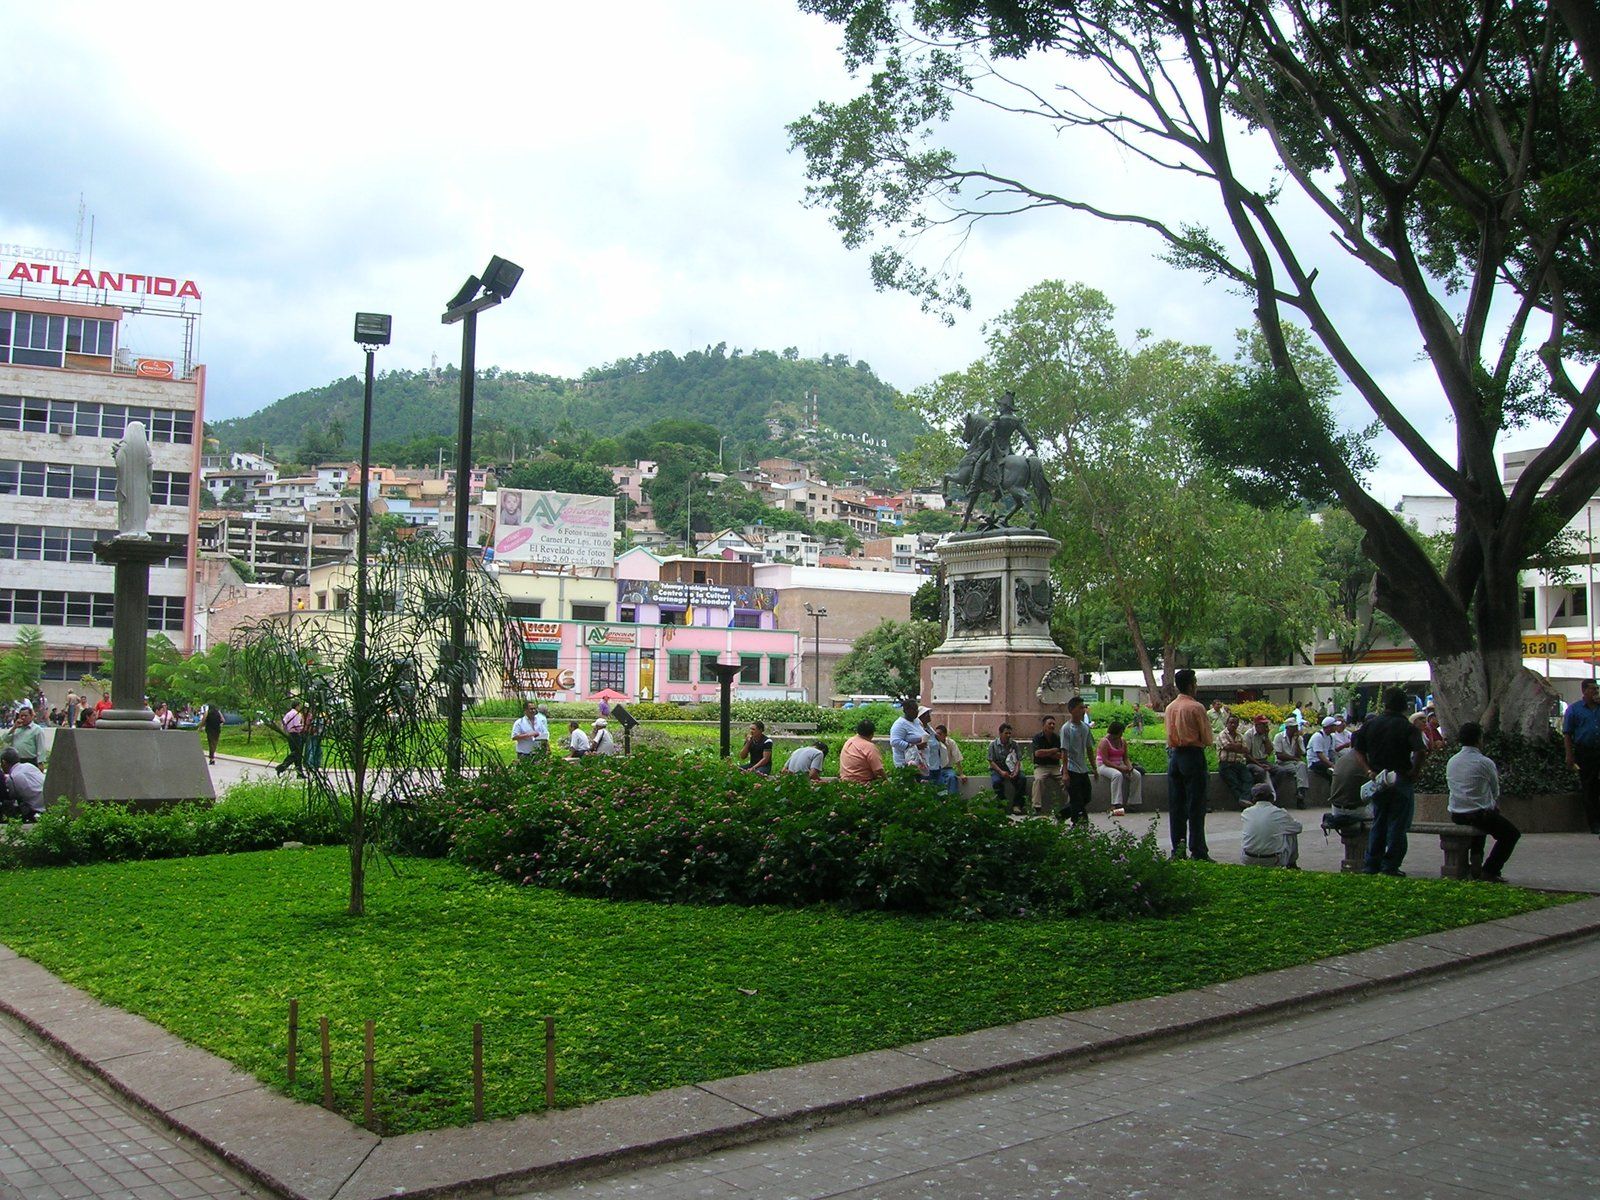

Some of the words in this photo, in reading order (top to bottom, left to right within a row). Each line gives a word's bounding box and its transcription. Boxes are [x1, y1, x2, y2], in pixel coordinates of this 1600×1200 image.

[8, 262, 201, 300] ATLANTIDA
[564, 528, 582, 536] Fotos
[541, 535, 562, 543] Carnet
[529, 544, 537, 552] El
[540, 545, 574, 555] Revelado
[577, 548, 585, 556] de
[588, 549, 606, 557] fotos
[591, 558, 605, 566] foto
[658, 589, 683, 597] Centro
